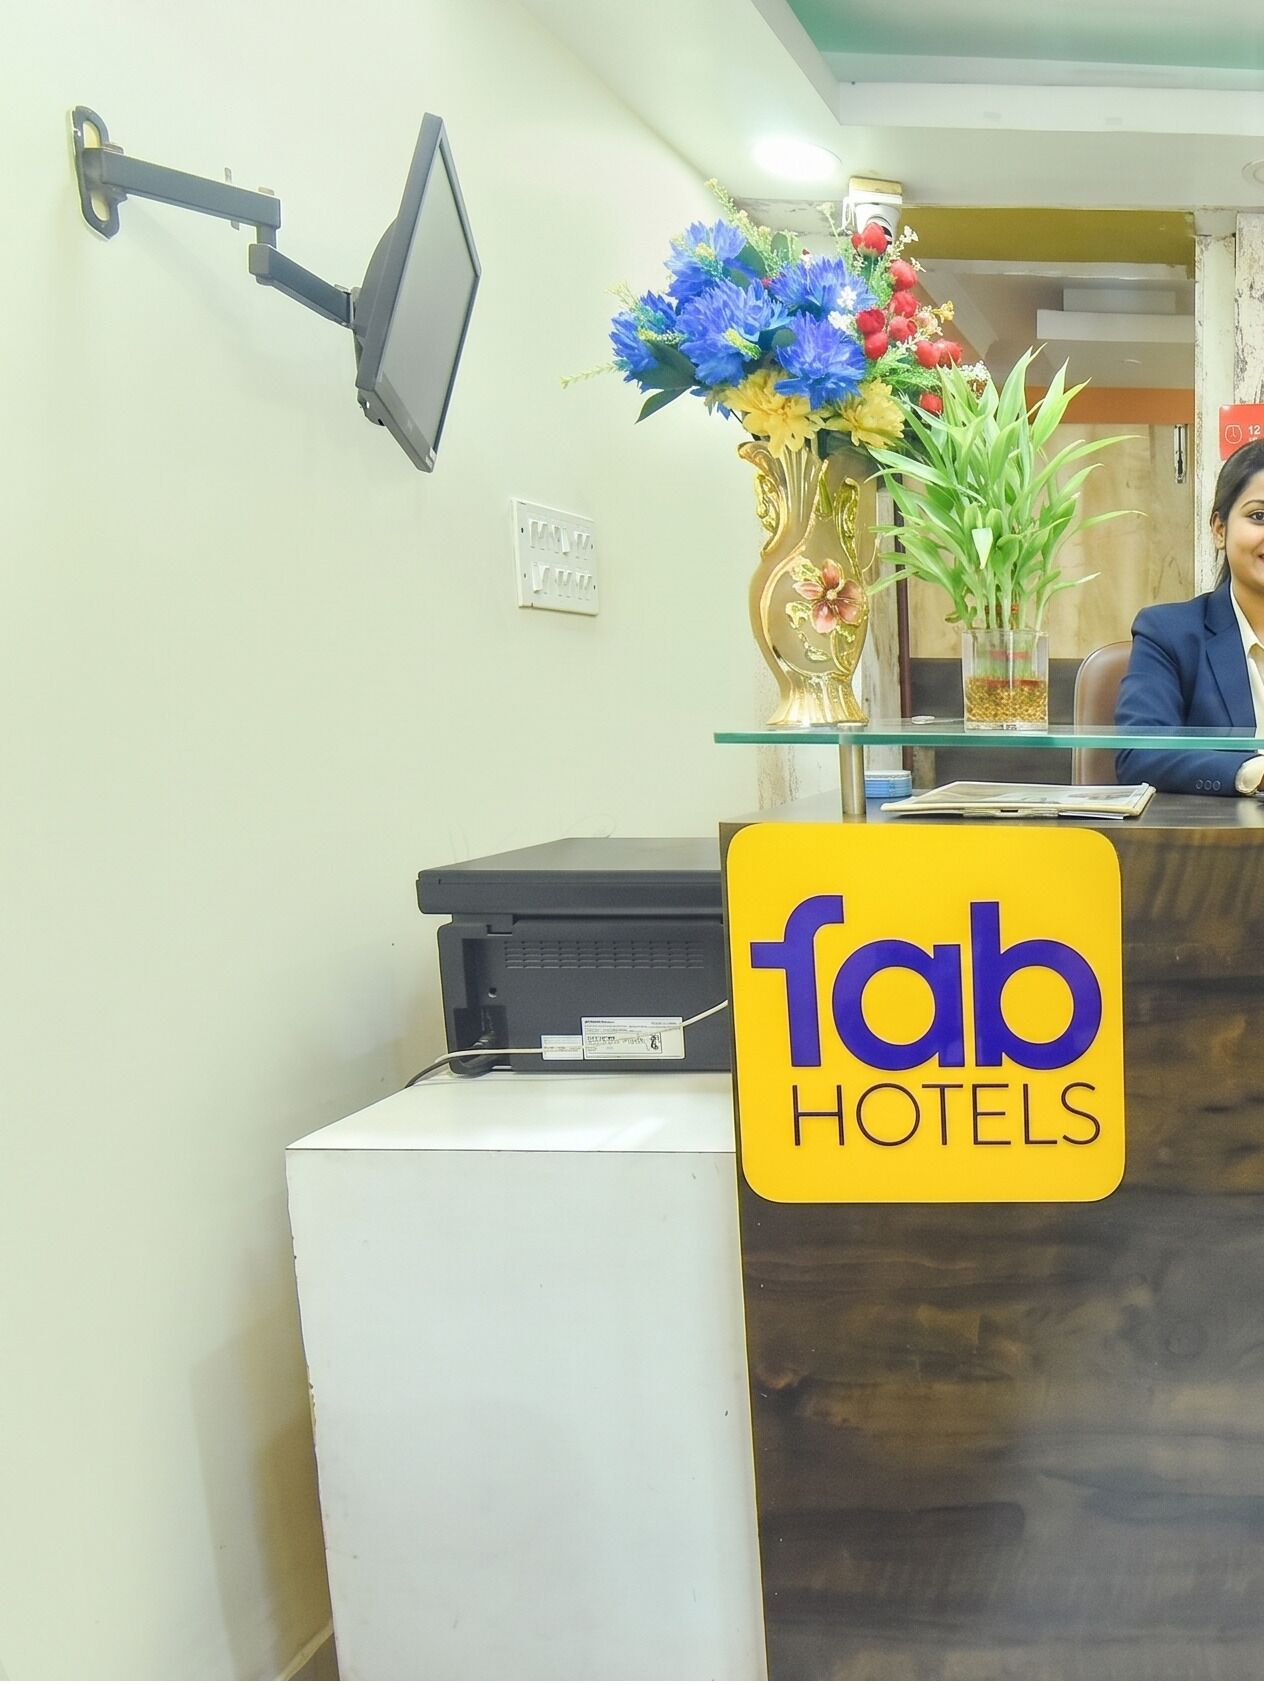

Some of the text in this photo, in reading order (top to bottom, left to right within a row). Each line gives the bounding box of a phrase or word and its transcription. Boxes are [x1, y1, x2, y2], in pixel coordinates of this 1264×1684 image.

[1248, 424, 1261, 435] 12
[750, 895, 1102, 1071] fab
[792, 1082, 1101, 1147] HOTELS
